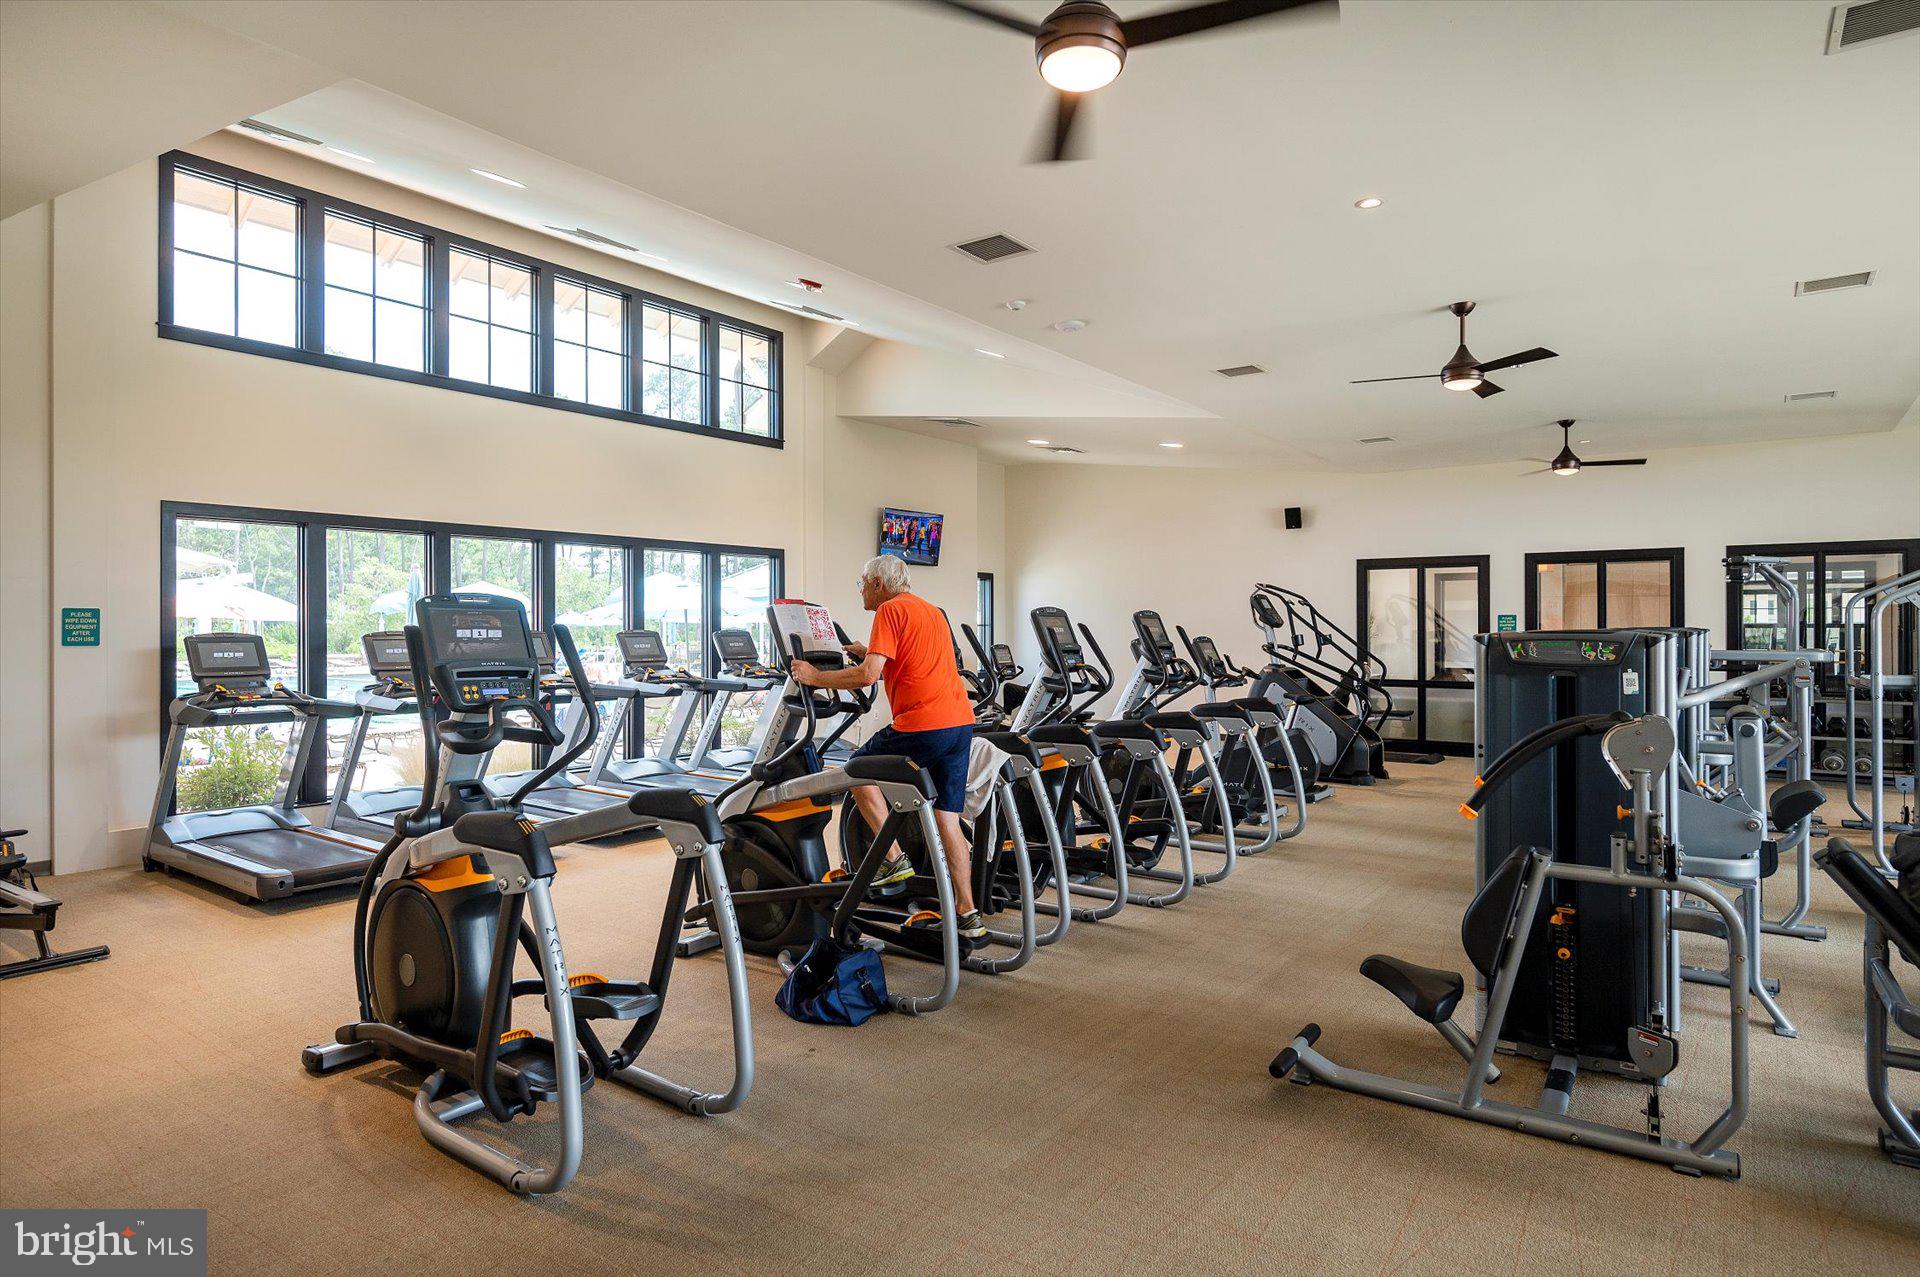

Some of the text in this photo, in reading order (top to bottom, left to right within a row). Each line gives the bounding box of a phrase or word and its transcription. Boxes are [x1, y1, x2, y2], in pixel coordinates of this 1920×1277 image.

[764, 706, 788, 757] MATRIX
[719, 884, 741, 944] MATRIX
[545, 925, 569, 996] MATRIX
